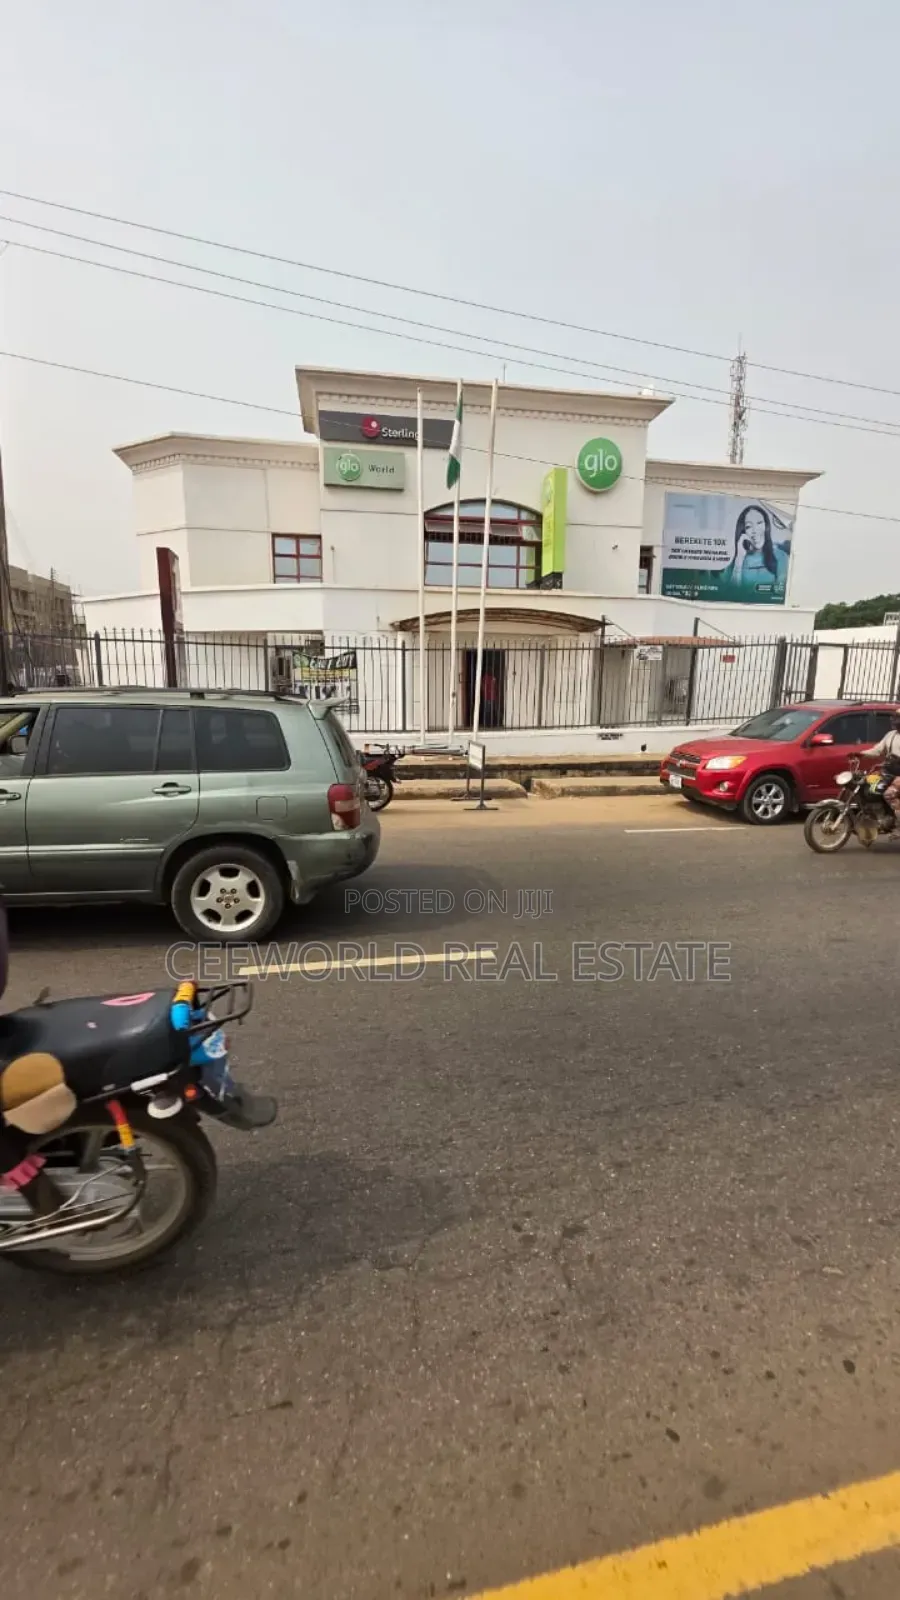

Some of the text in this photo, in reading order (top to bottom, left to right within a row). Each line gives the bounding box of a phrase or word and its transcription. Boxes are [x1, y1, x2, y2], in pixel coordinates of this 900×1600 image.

[340, 459, 395, 474] glo World
[584, 449, 618, 477] glo
